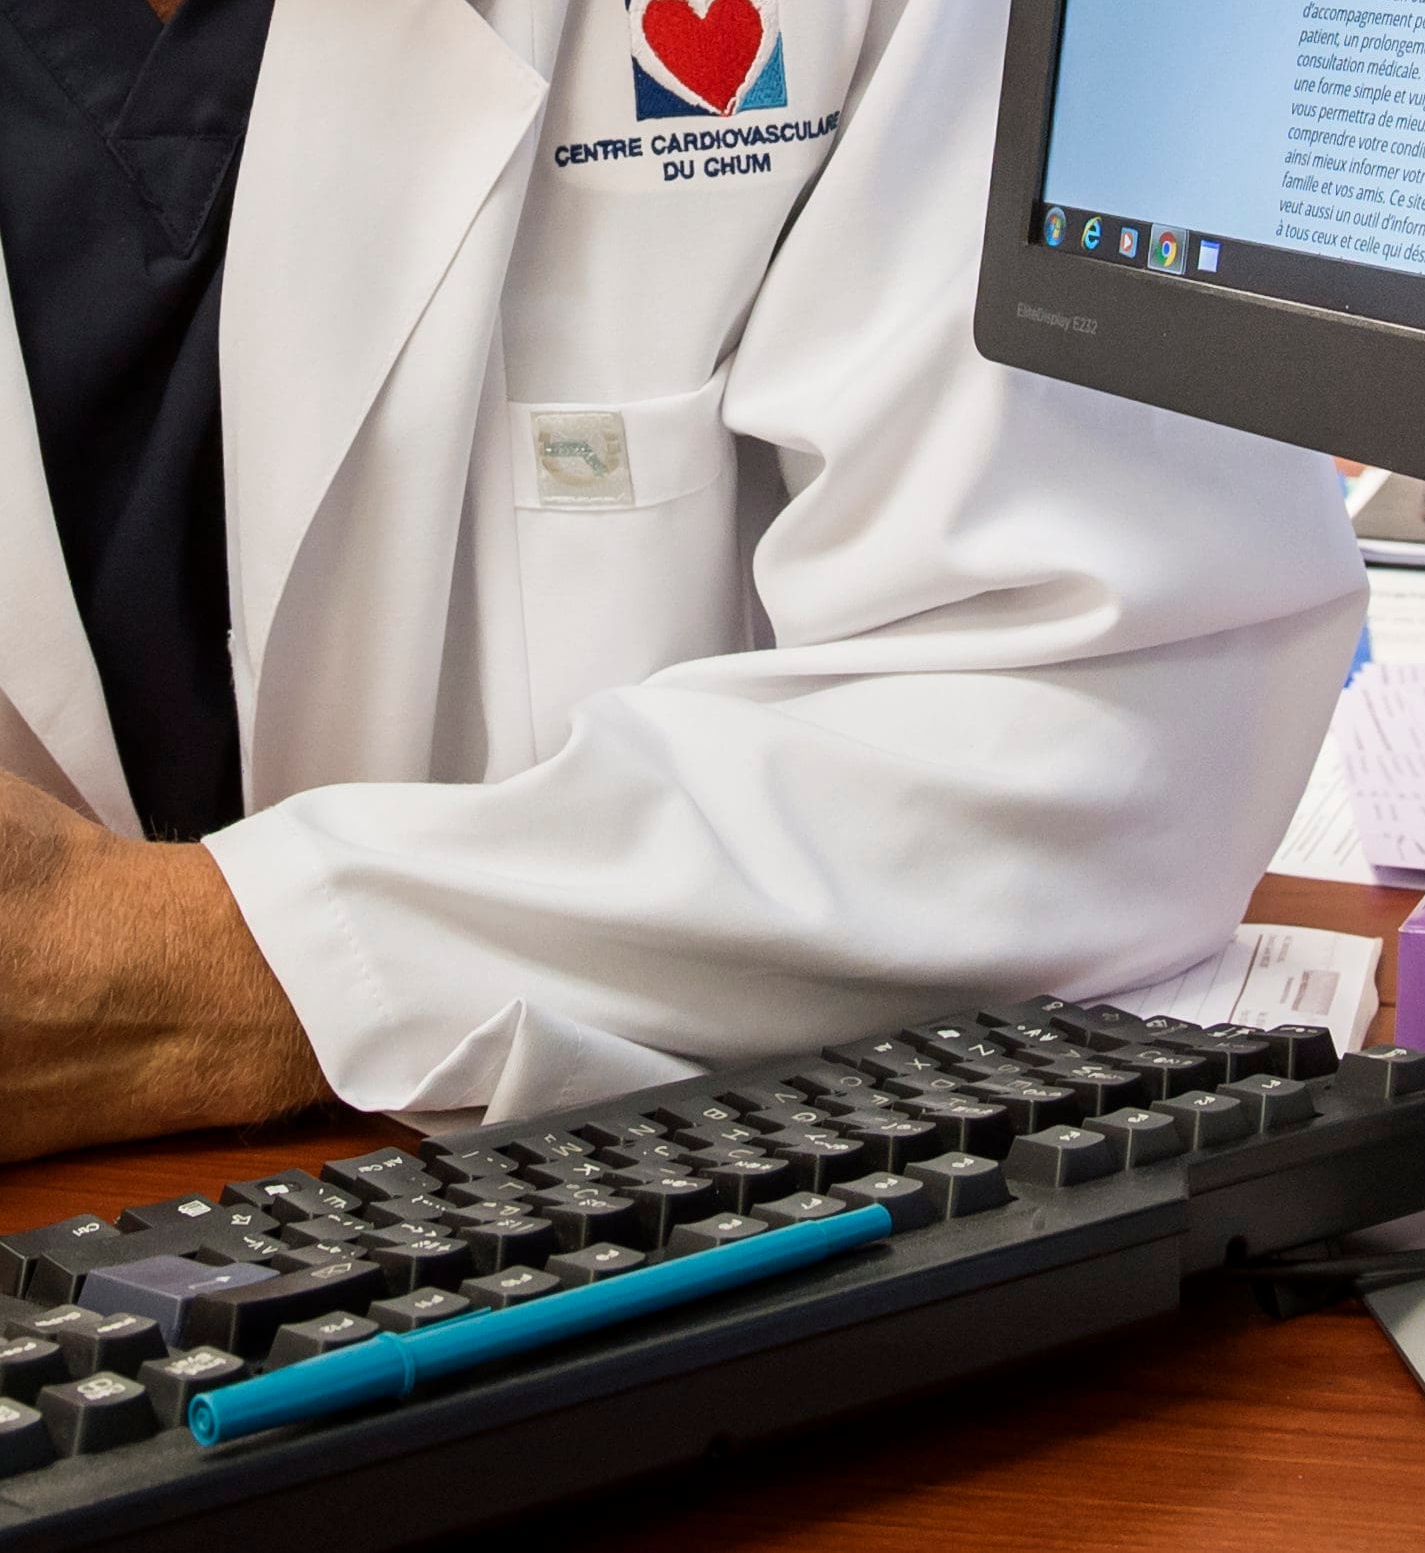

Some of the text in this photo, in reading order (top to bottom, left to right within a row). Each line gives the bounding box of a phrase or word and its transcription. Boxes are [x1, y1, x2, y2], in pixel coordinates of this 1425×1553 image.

[1303, 1, 1413, 28] d'accompagnement
[1298, 28, 1339, 47] patient,
[1343, 33, 1359, 48] un
[1297, 53, 1365, 74] consultation
[1366, 59, 1421, 80] médicale.
[1293, 77, 1315, 93] une
[1316, 76, 1351, 97] forme
[1353, 83, 1391, 105] simple
[1394, 88, 1407, 103] et
[1291, 101, 1317, 118] vous
[1318, 104, 1375, 126] permettra
[1377, 110, 1393, 128] de
[554, 136, 643, 167] CENTRE
[1287, 126, 1356, 148] comprendre
[1358, 134, 1389, 153] votre
[663, 152, 772, 181] DU CHUM
[1284, 148, 1311, 166] ainsi
[1312, 153, 1347, 172] mieux
[1348, 157, 1400, 181] informer
[1281, 170, 1319, 193] famille
[1320, 180, 1333, 196] et
[1335, 183, 1354, 199] vos
[1355, 185, 1386, 204] amis.
[1389, 189, 1405, 207] Ce
[1279, 199, 1303, 216] veut
[1304, 202, 1334, 221] aussi
[1335, 208, 1351, 223] un
[1352, 208, 1380, 229] outil
[1275, 219, 1284, 237] à
[1285, 223, 1309, 241] tous
[1311, 229, 1337, 247] ceux
[1339, 233, 1353, 249] et
[1354, 235, 1380, 255] celle
[1382, 241, 1402, 262] qui
